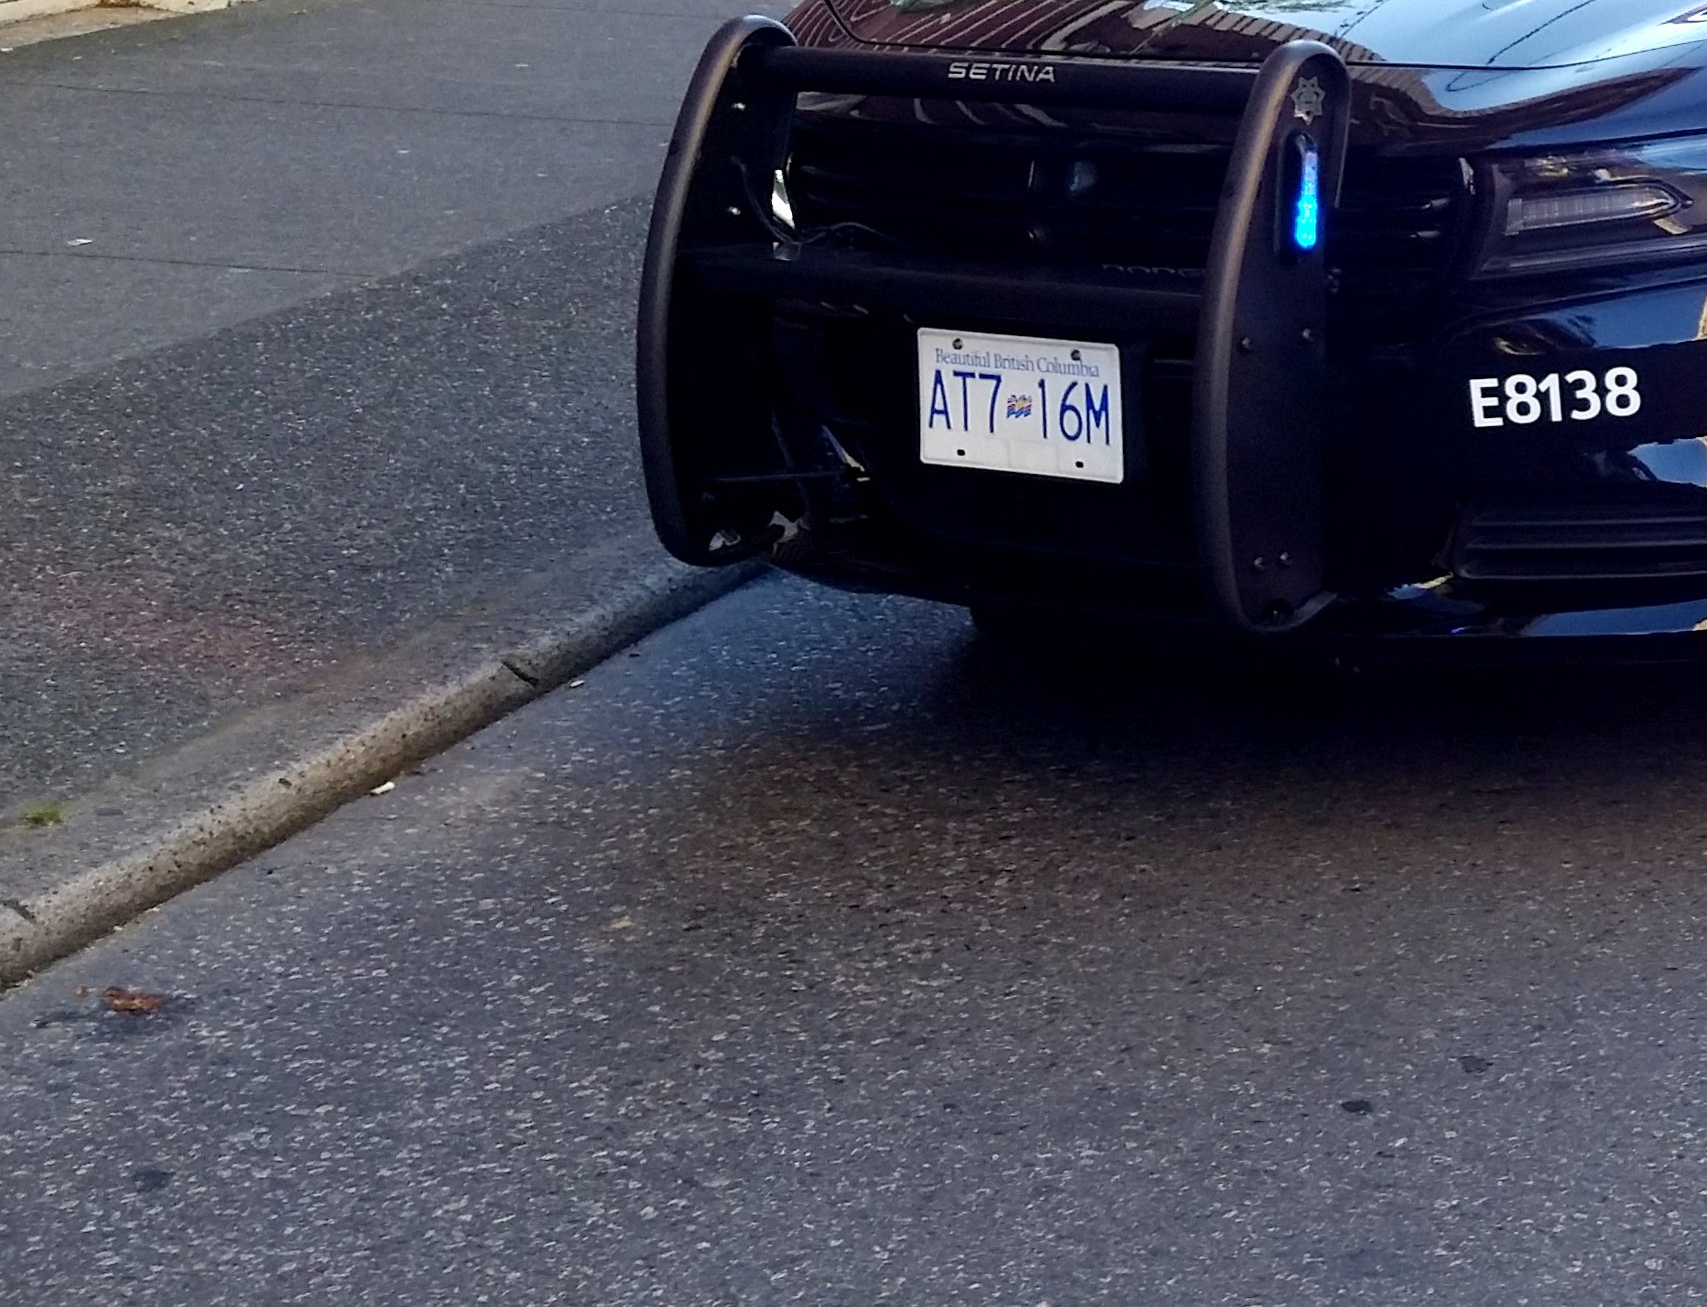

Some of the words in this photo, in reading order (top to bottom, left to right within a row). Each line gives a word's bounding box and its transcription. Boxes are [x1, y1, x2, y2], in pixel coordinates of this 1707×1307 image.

[947, 61, 1056, 83] SETINA
[935, 347, 991, 368] Beautiful
[994, 354, 1035, 372] British
[1036, 356, 1101, 378] Columbia
[928, 369, 1003, 434] AT7
[1037, 378, 1111, 447] 16M
[1468, 366, 1642, 428] E8138
